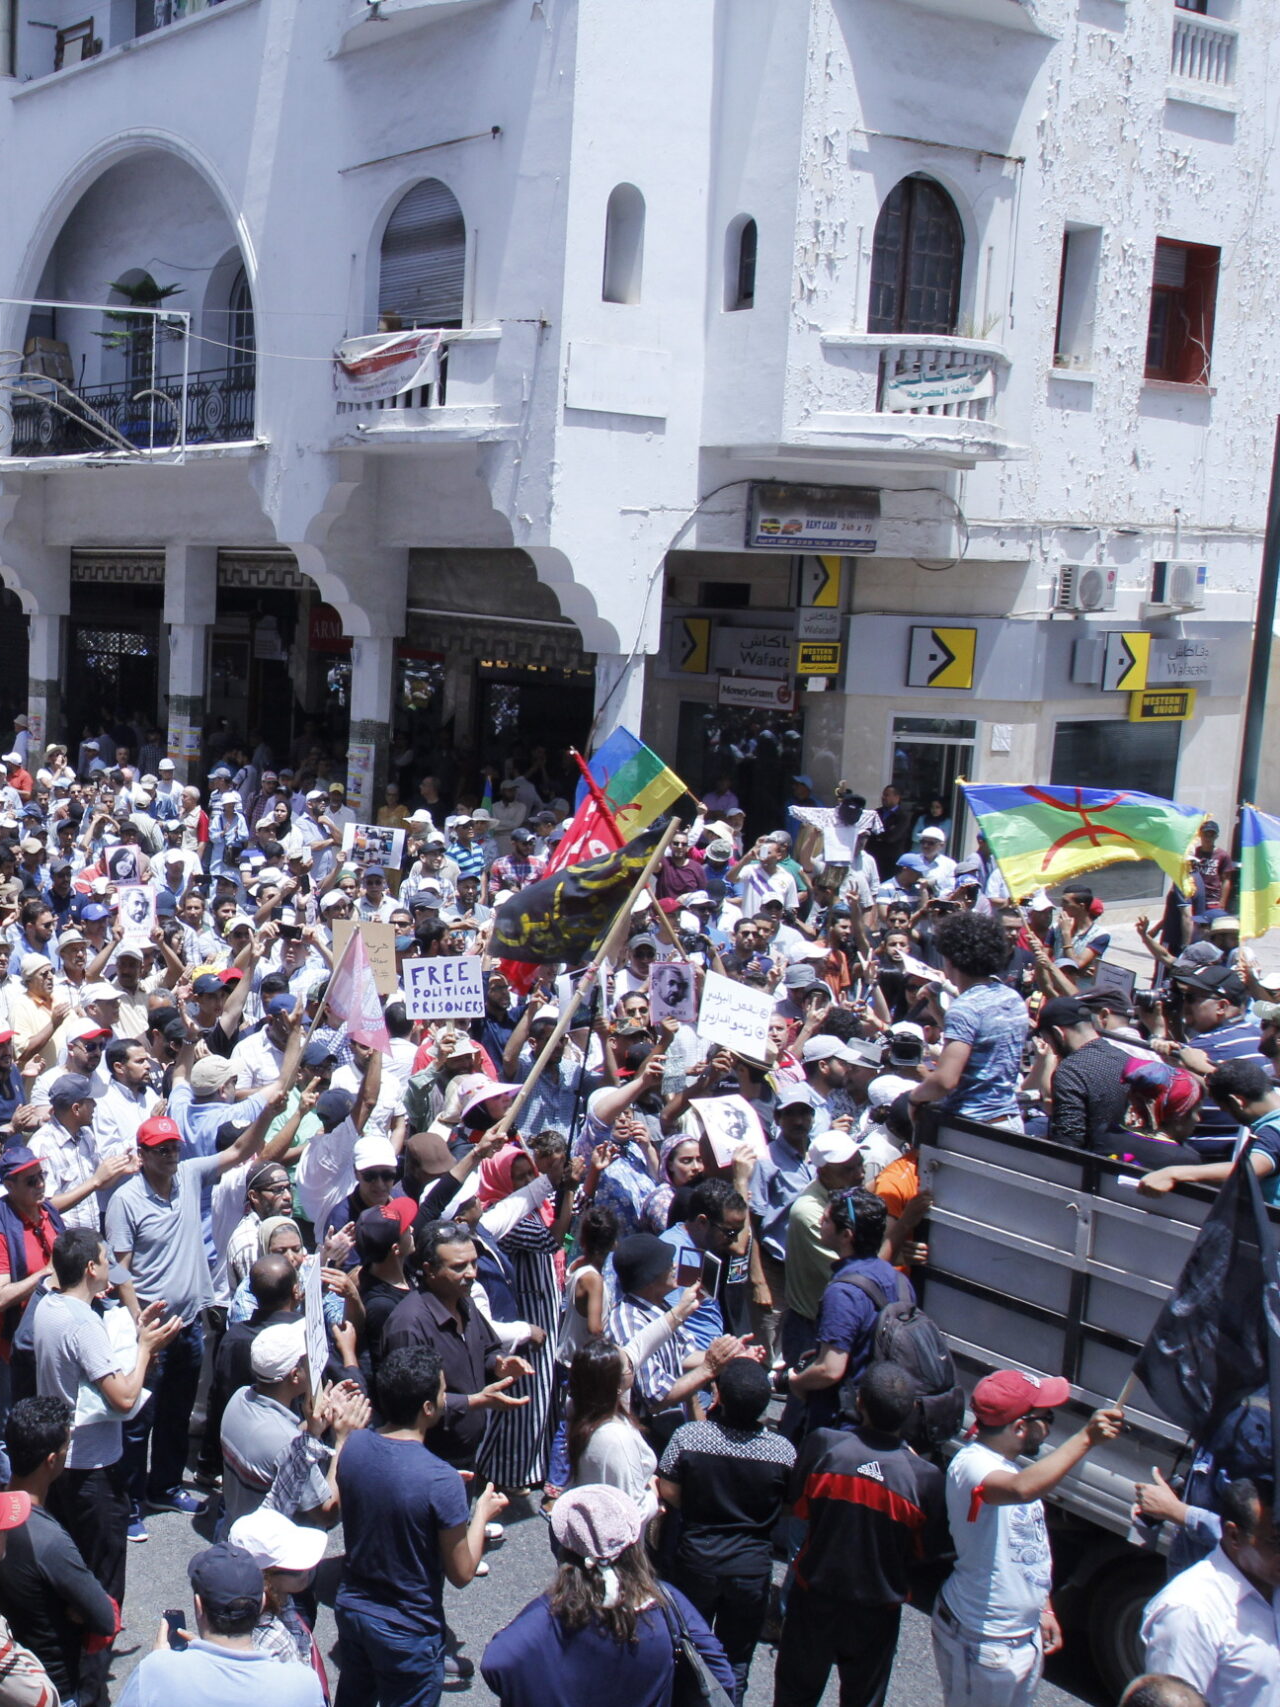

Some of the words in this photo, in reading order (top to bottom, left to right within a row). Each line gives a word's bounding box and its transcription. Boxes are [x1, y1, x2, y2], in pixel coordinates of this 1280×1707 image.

[805, 519, 821, 530] RENT
[822, 520, 838, 531] CARS
[722, 684, 774, 699] MoneyGram
[410, 962, 469, 986] FREE
[413, 984, 481, 998] POLITICAL
[412, 1000, 484, 1014] PRISONERS
